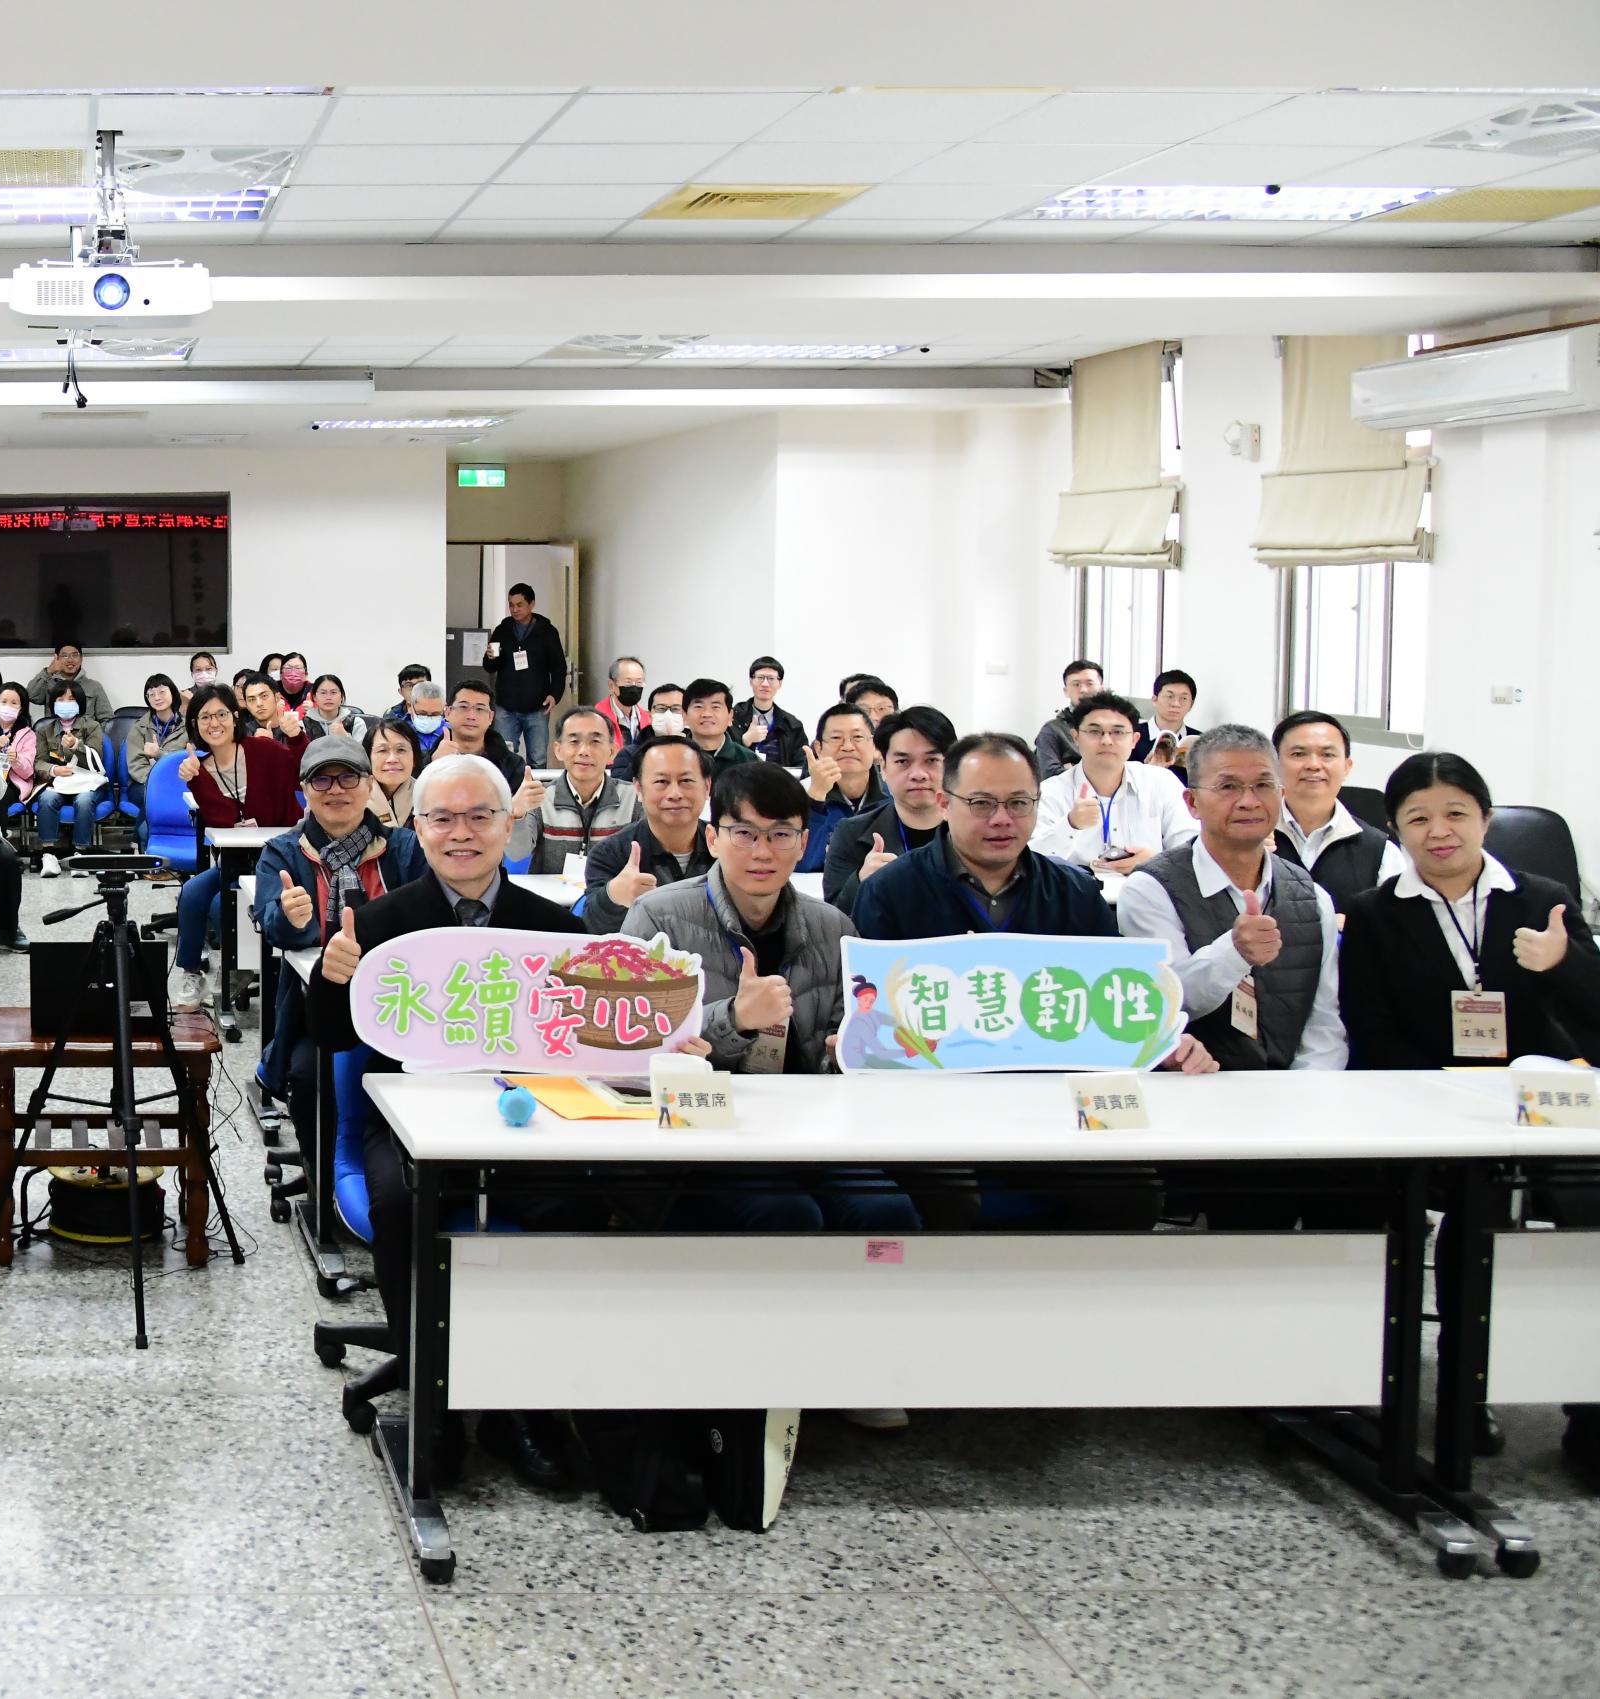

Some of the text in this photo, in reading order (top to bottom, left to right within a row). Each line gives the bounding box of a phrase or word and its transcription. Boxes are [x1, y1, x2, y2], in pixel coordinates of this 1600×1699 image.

[375, 951, 671, 1057] 永續安心
[907, 965, 1158, 1034] 智慧韌性
[677, 1092, 727, 1108] 貴賓席
[1092, 1094, 1139, 1111] 貴賓席
[1537, 1091, 1592, 1106] 貴賓席
